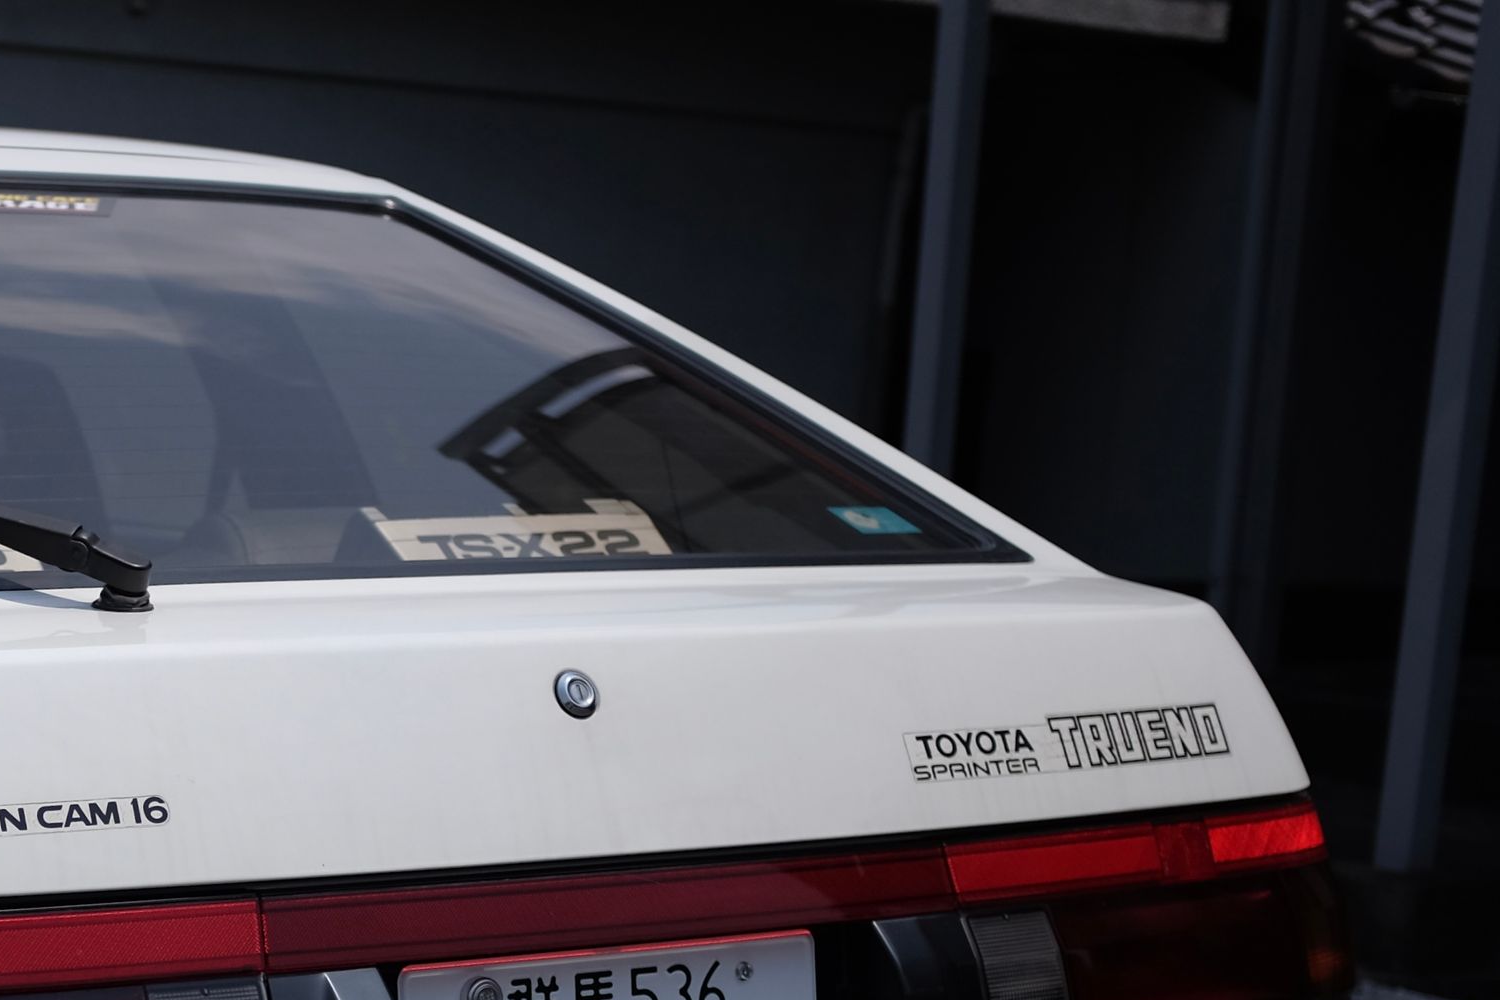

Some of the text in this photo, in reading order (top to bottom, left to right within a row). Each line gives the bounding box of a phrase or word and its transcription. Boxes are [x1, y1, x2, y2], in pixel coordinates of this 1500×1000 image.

[915, 729, 1035, 760] TOYOTA
[1046, 702, 1231, 770] TRUENO
[913, 757, 1041, 782] SPRINTER
[36, 801, 122, 829] CAM
[131, 796, 170, 825] 16
